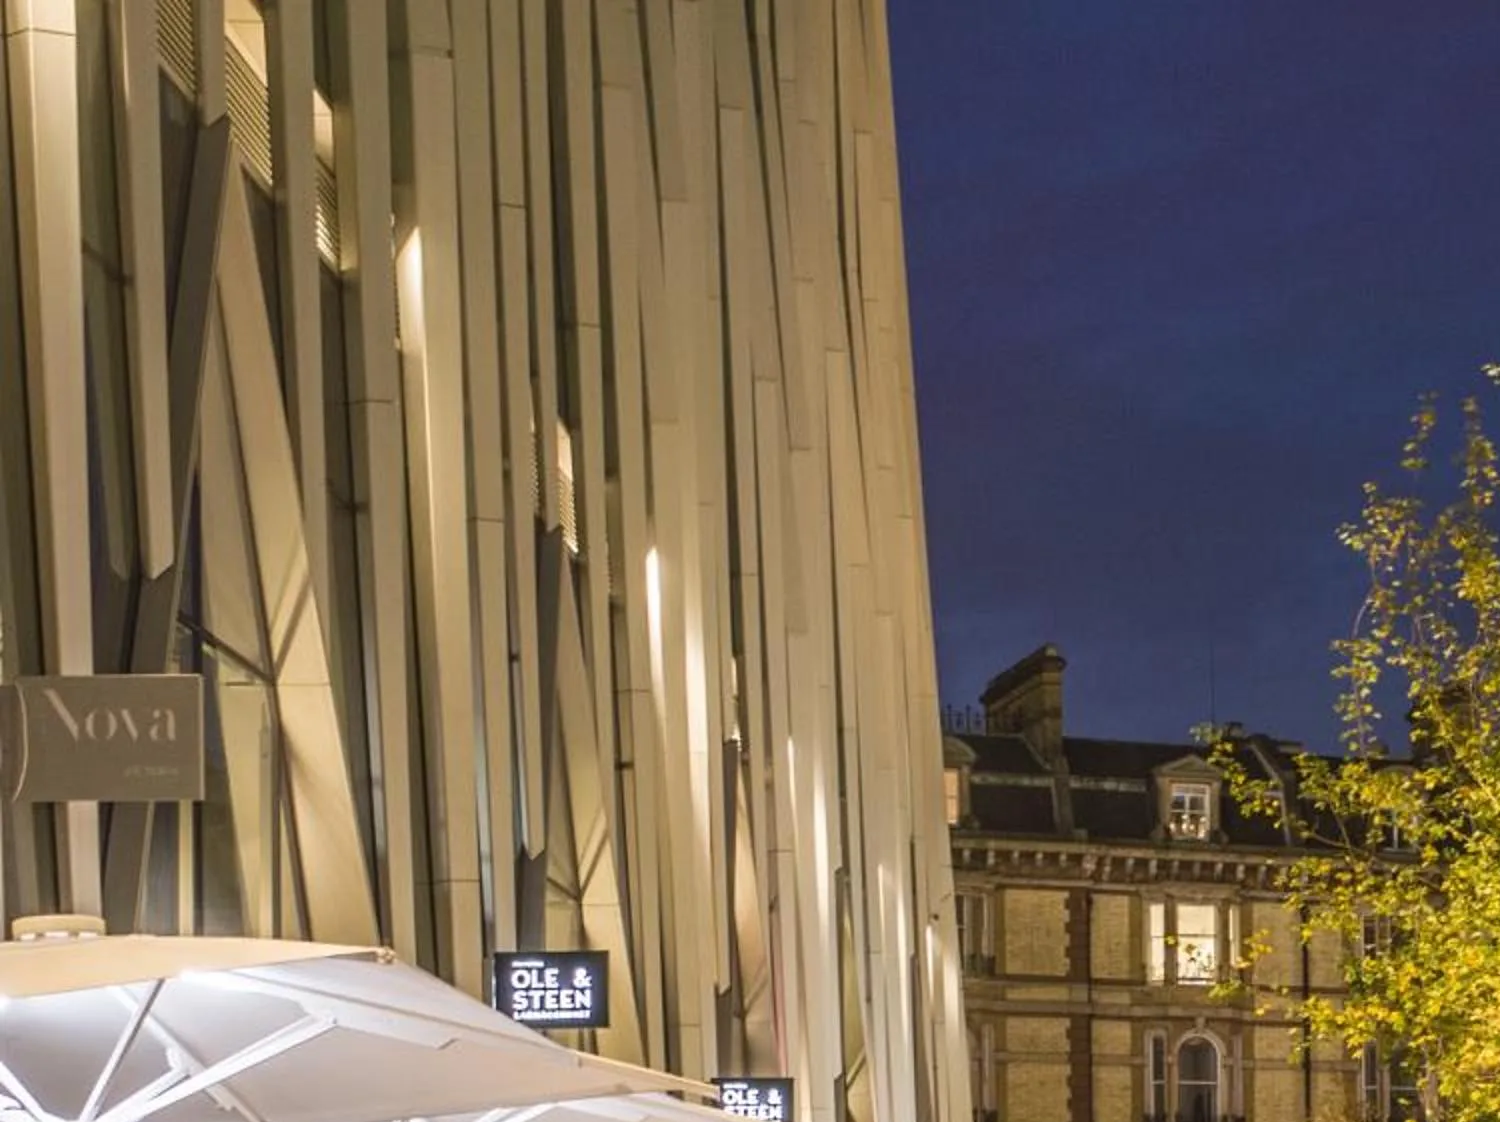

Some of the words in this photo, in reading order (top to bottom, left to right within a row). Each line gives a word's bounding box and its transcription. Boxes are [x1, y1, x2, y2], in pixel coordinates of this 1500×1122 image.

[43, 687, 177, 742] Nova
[511, 968, 559, 989] OLE
[572, 967, 593, 989] &
[512, 989, 592, 1010] STEEN
[722, 1089, 759, 1105] OLE
[767, 1088, 783, 1105] &
